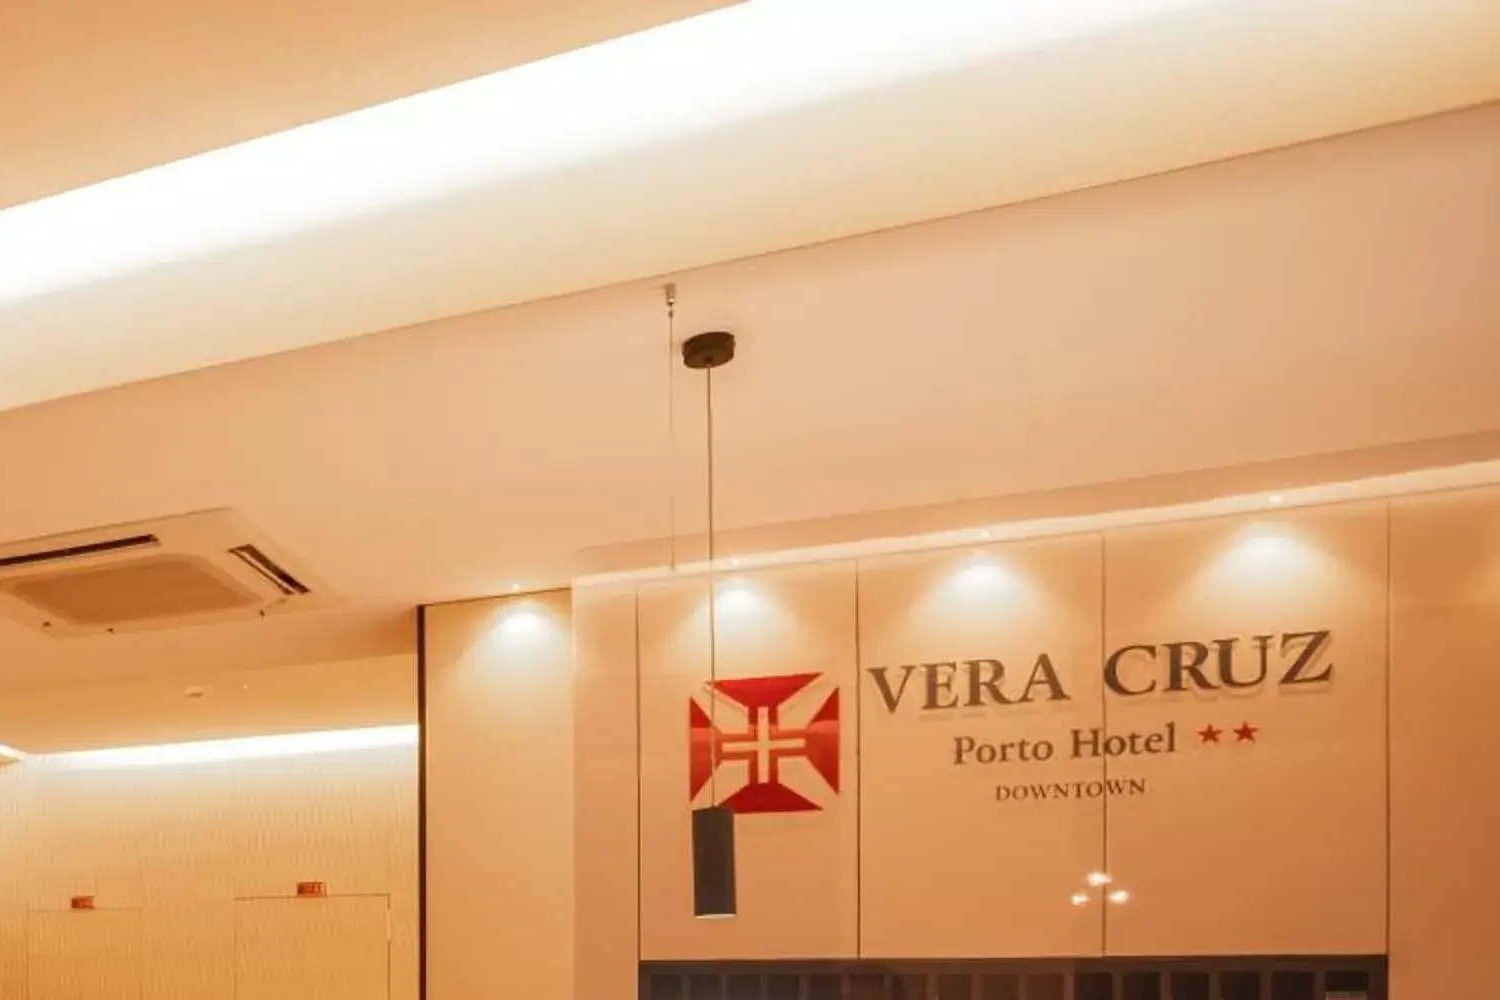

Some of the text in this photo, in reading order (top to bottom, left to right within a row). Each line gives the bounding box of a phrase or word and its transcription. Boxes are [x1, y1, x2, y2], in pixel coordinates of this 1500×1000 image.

[865, 630, 1333, 714] VERA CRUZ
[953, 720, 1176, 765] Porto Hotel
[995, 777, 1147, 802] DOWNTOWN
